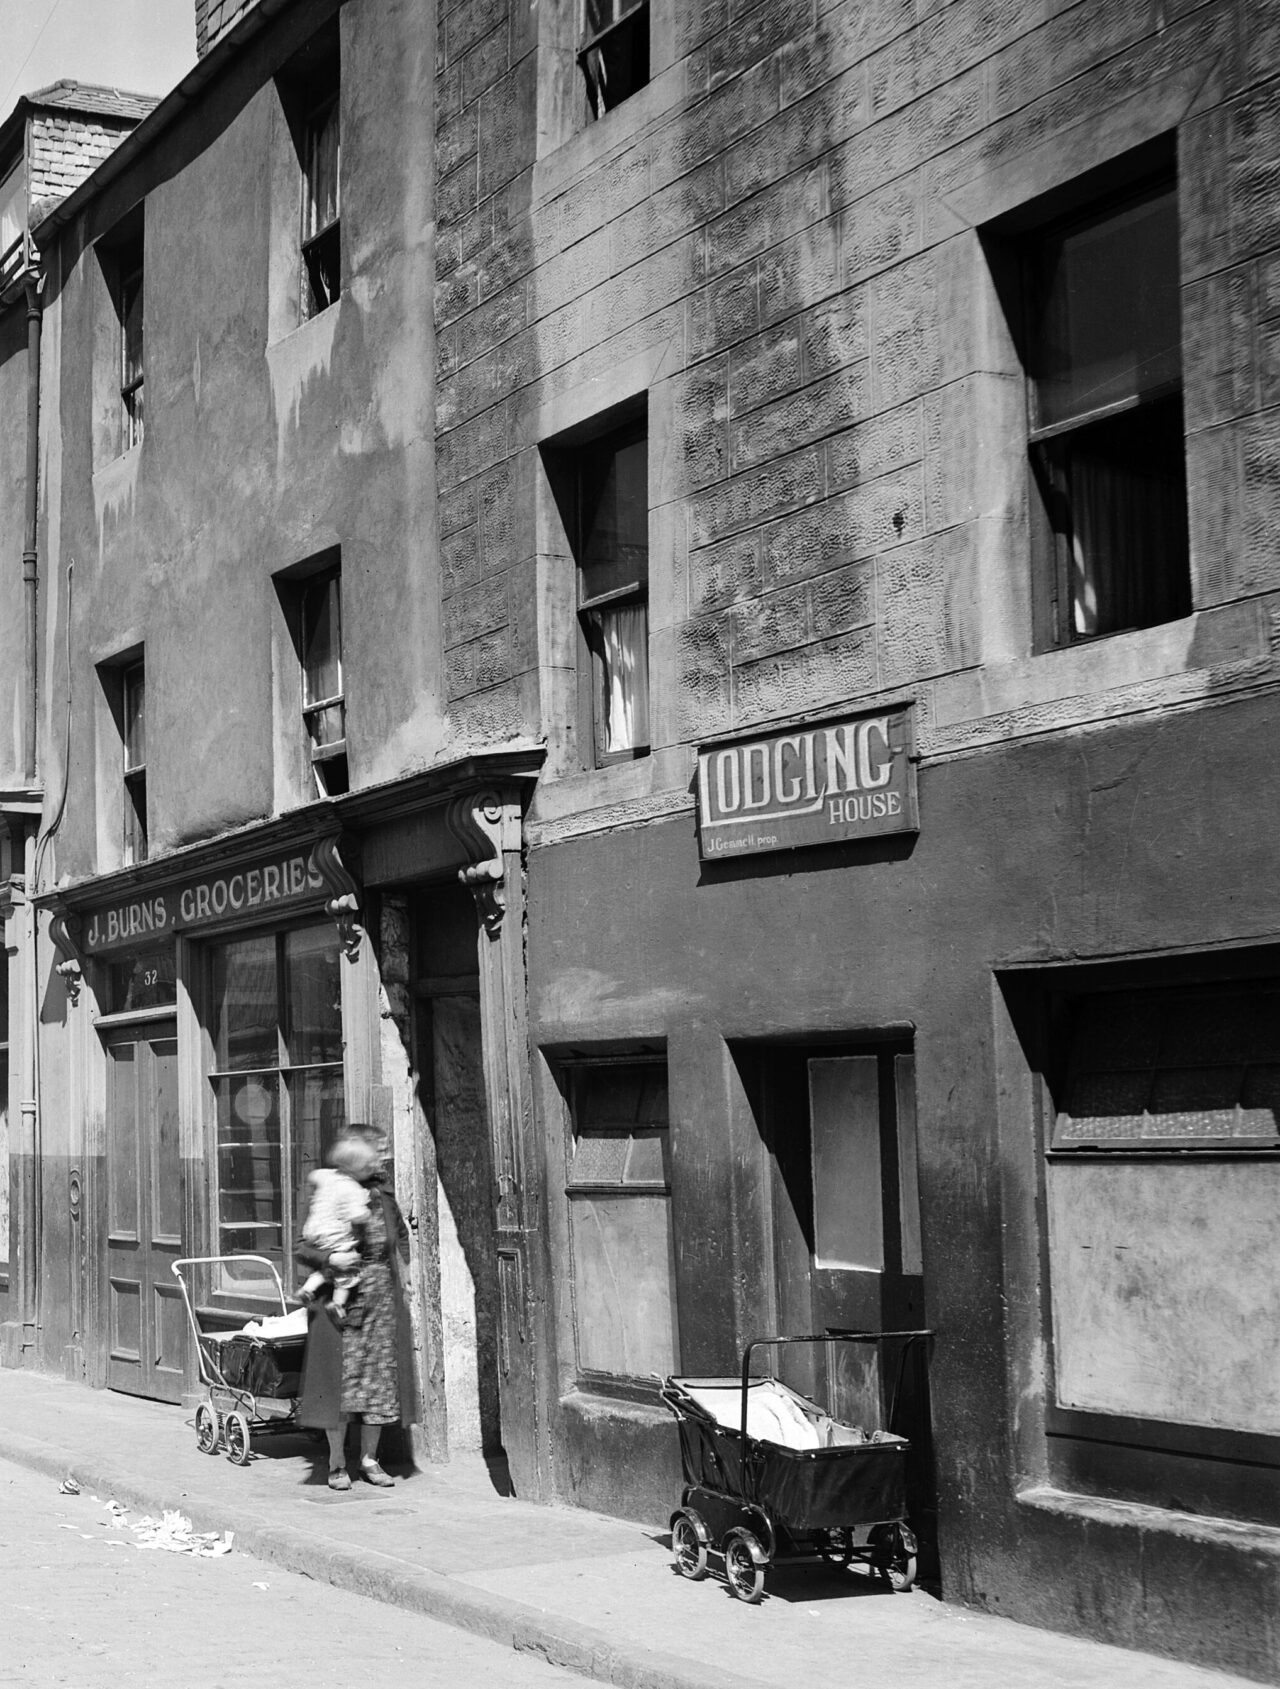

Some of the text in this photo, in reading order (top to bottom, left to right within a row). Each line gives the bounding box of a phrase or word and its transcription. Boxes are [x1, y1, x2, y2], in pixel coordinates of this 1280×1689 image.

[698, 718, 893, 827] LODGING
[829, 791, 902, 825] HOUSE
[180, 853, 324, 922] GROCERIES
[144, 969, 158, 986] 32
